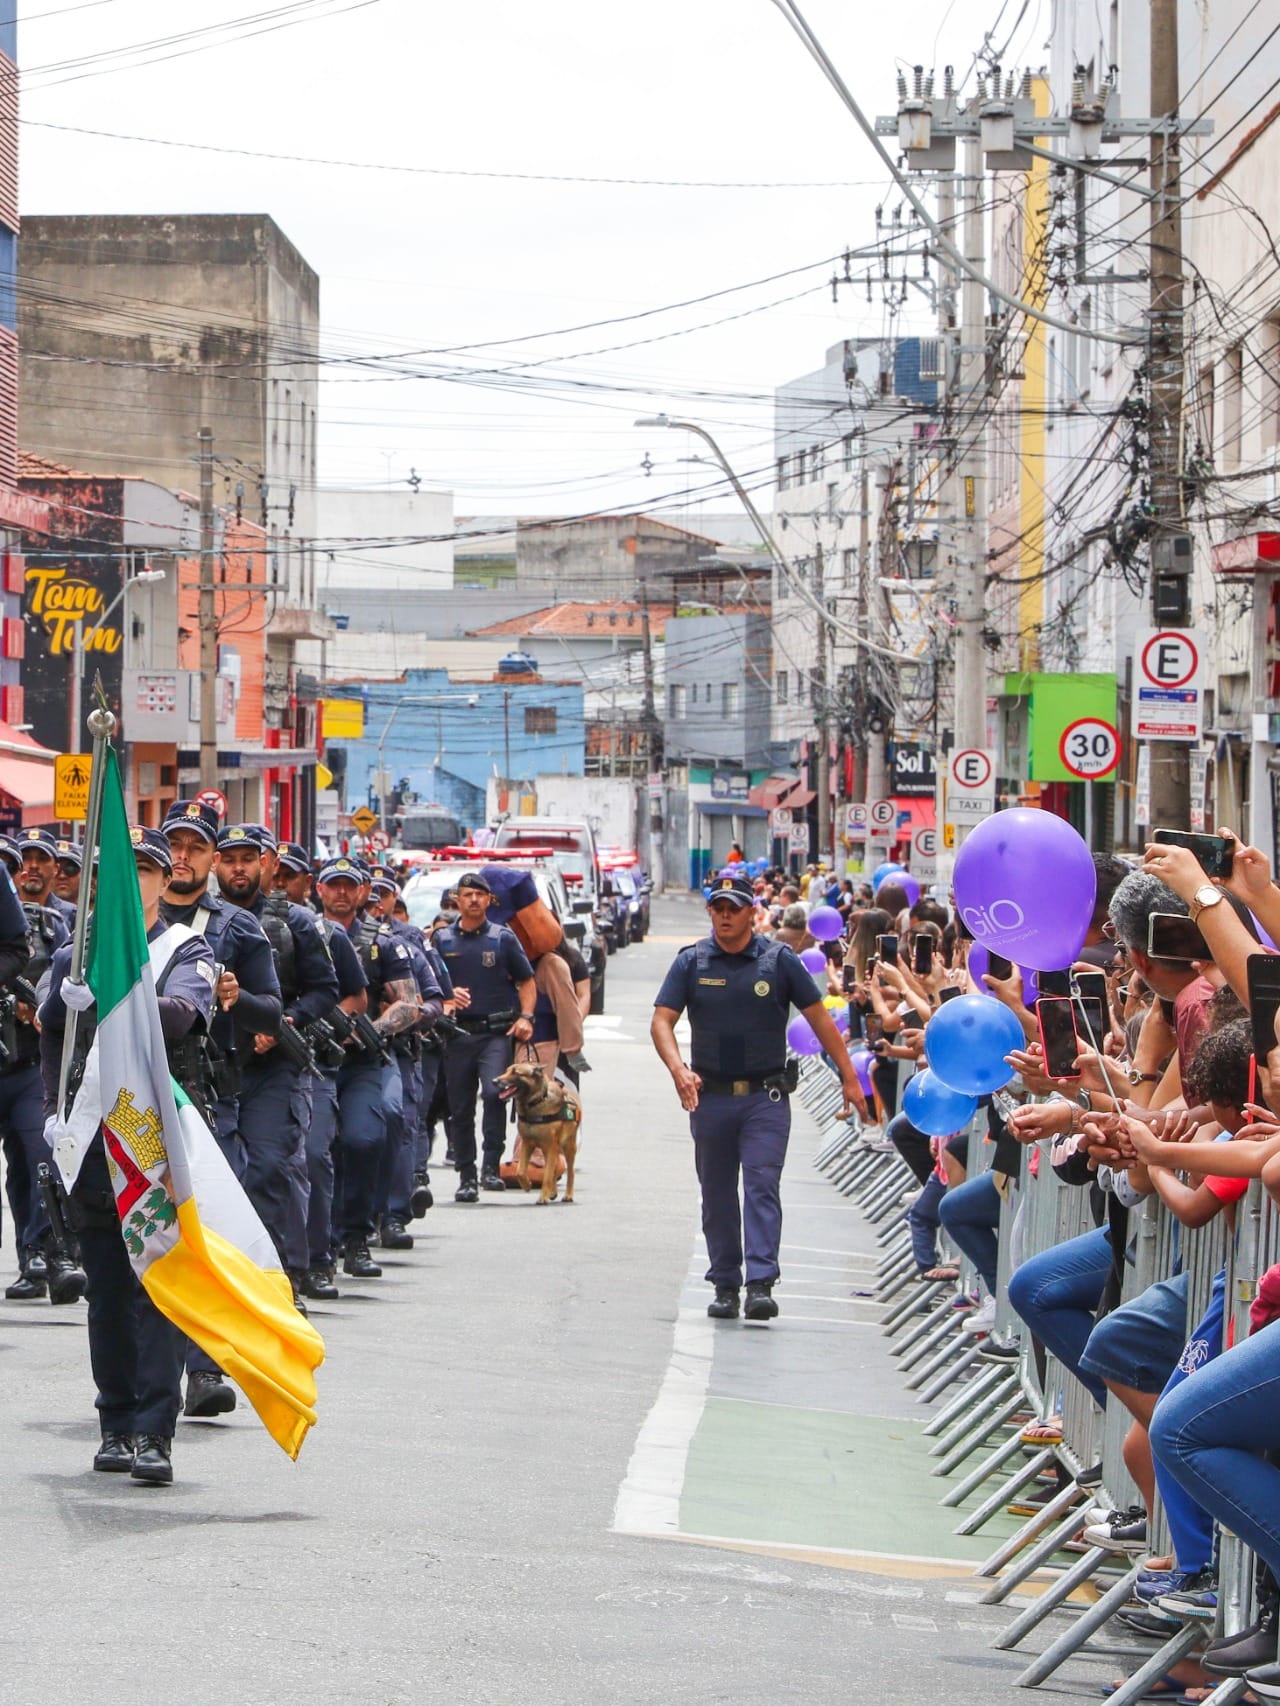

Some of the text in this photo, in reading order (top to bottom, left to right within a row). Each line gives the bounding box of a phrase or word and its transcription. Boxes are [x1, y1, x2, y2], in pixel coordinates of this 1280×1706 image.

[25, 568, 104, 614] Tom
[1157, 644, 1180, 679] E
[1072, 734, 1110, 757] 30
[897, 750, 923, 773] Sol
[964, 759, 979, 780] E
[878, 806, 887, 820] E
[959, 800, 982, 811] TAXI
[924, 835, 935, 851] E
